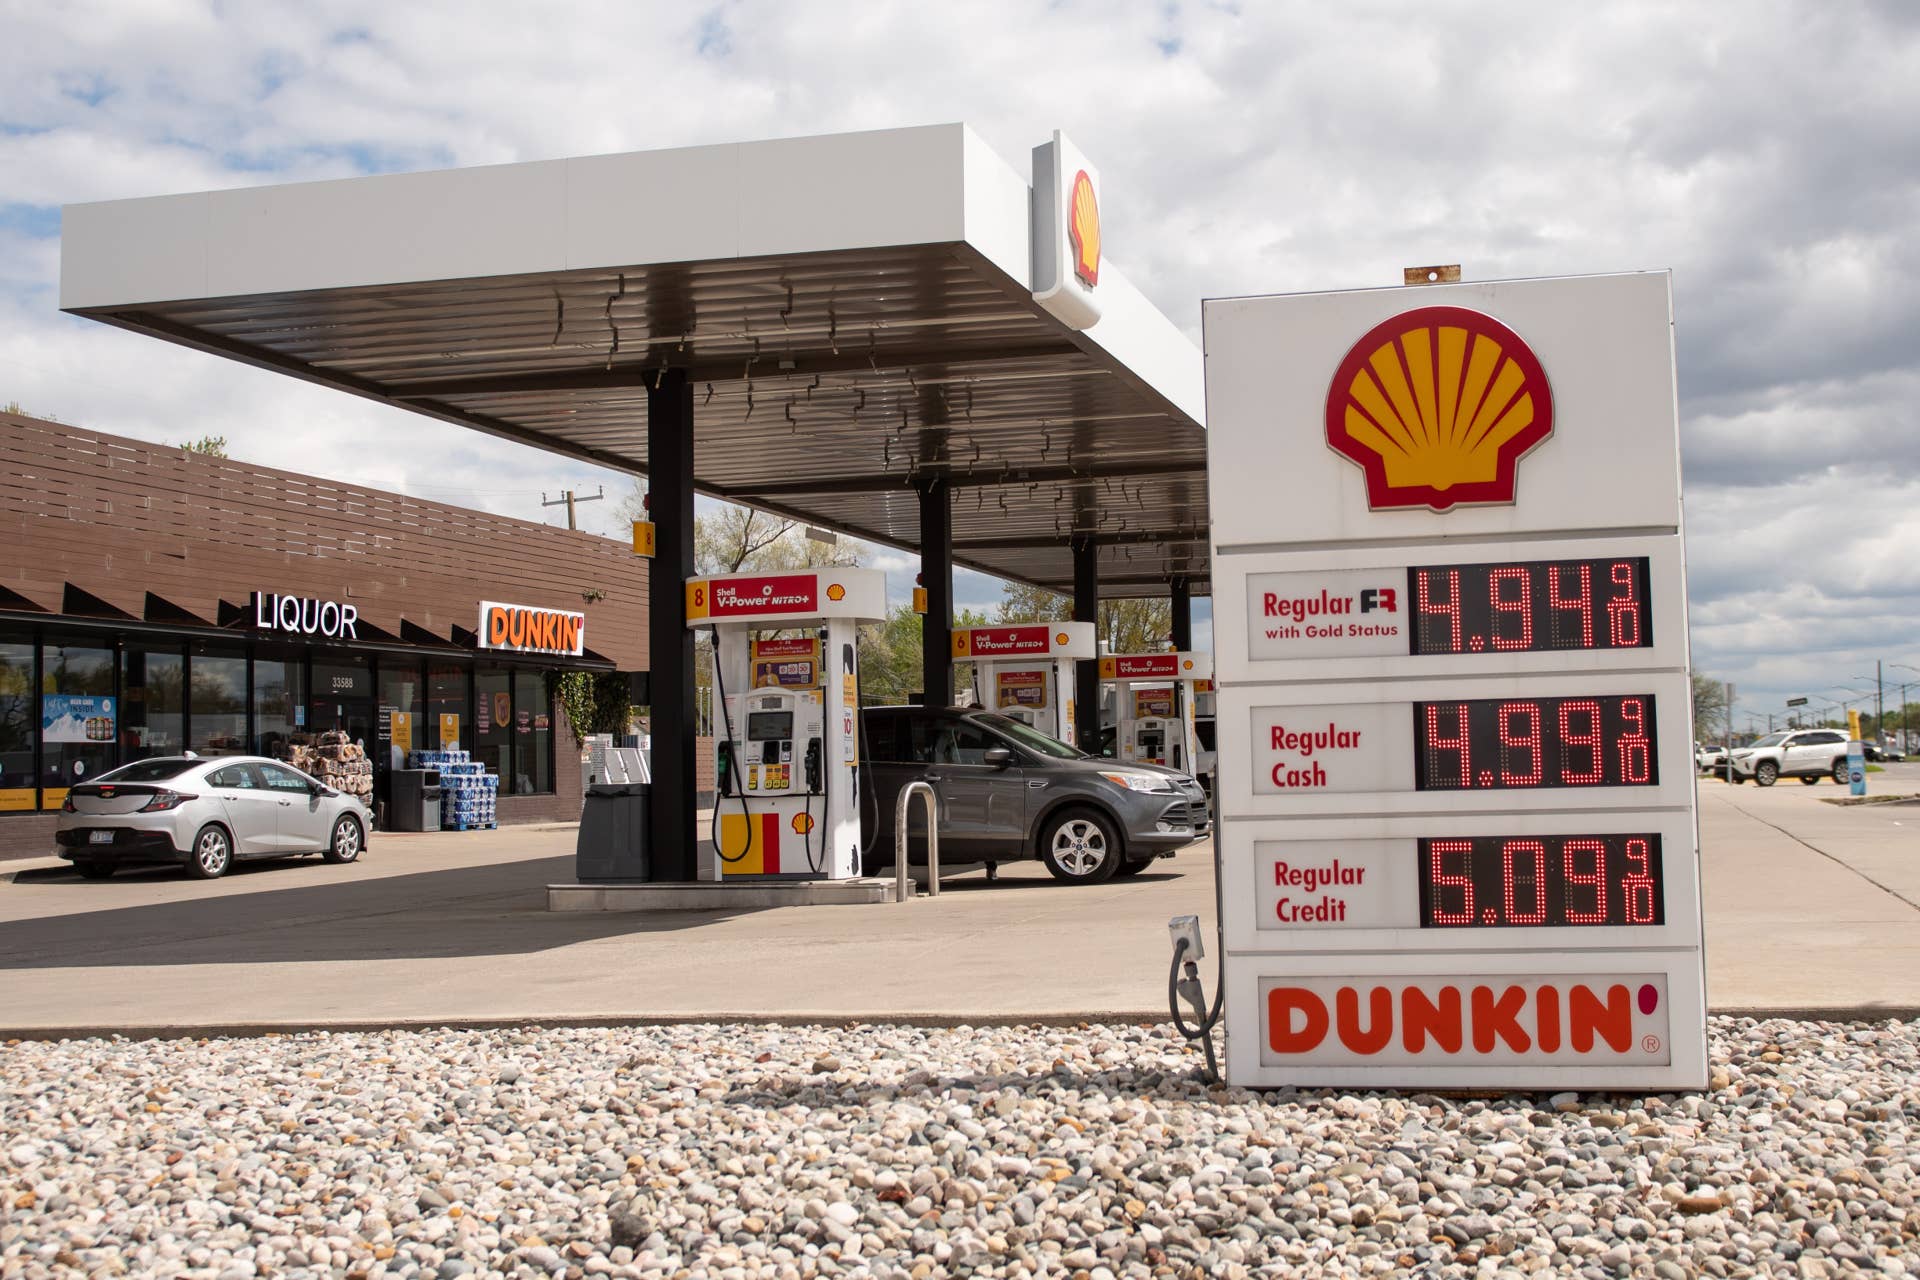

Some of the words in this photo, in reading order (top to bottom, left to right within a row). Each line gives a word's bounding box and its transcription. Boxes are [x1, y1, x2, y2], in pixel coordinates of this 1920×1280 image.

[694, 588, 705, 607] 8
[716, 587, 736, 598] Shell
[717, 596, 769, 608] V-Power
[1263, 589, 1354, 623] Regular
[257, 591, 358, 640] LIQUOR
[1417, 565, 1594, 652] 4.94
[957, 635, 966, 649] 6
[1265, 625, 1300, 639] with
[1305, 624, 1344, 638] Gold
[1348, 623, 1399, 638] Status
[976, 641, 1015, 650] V-Power
[1104, 661, 1112, 673] 4
[1271, 722, 1361, 757] Regular
[1427, 701, 1604, 787] 4.99
[1272, 760, 1327, 788] Cash
[1275, 859, 1366, 893] Regular
[1431, 840, 1608, 924] 5.09
[1276, 896, 1347, 923] Credit
[1268, 984, 1658, 1055] DUNKIN'
